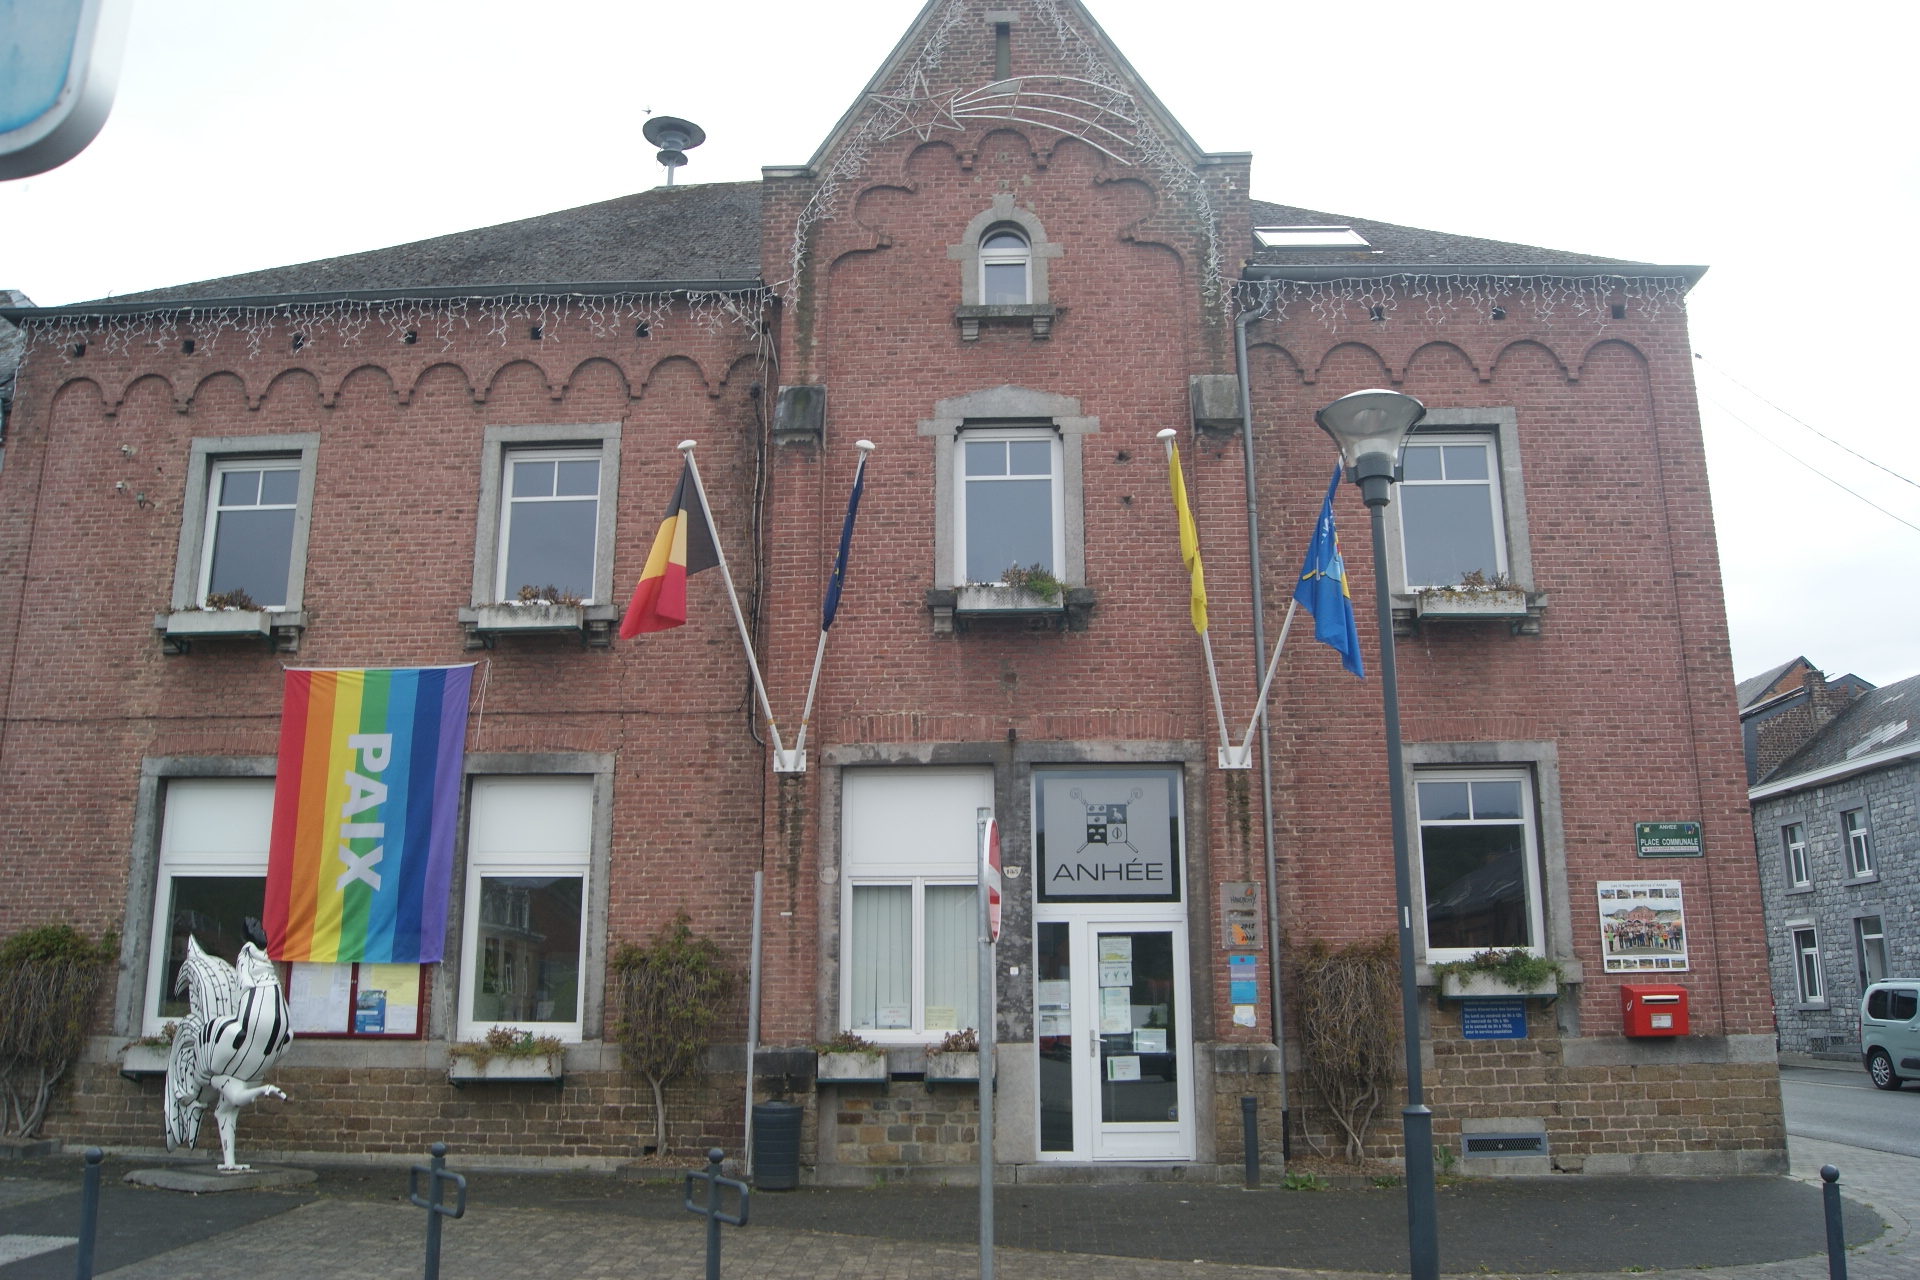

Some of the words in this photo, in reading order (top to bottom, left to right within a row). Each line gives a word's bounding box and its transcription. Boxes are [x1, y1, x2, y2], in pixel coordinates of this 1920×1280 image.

[336, 733, 393, 892] PAIX
[1640, 838, 1660, 846] PLACE
[1661, 837, 1699, 846] COMMUNALE
[1052, 857, 1164, 882] ANHÉE
